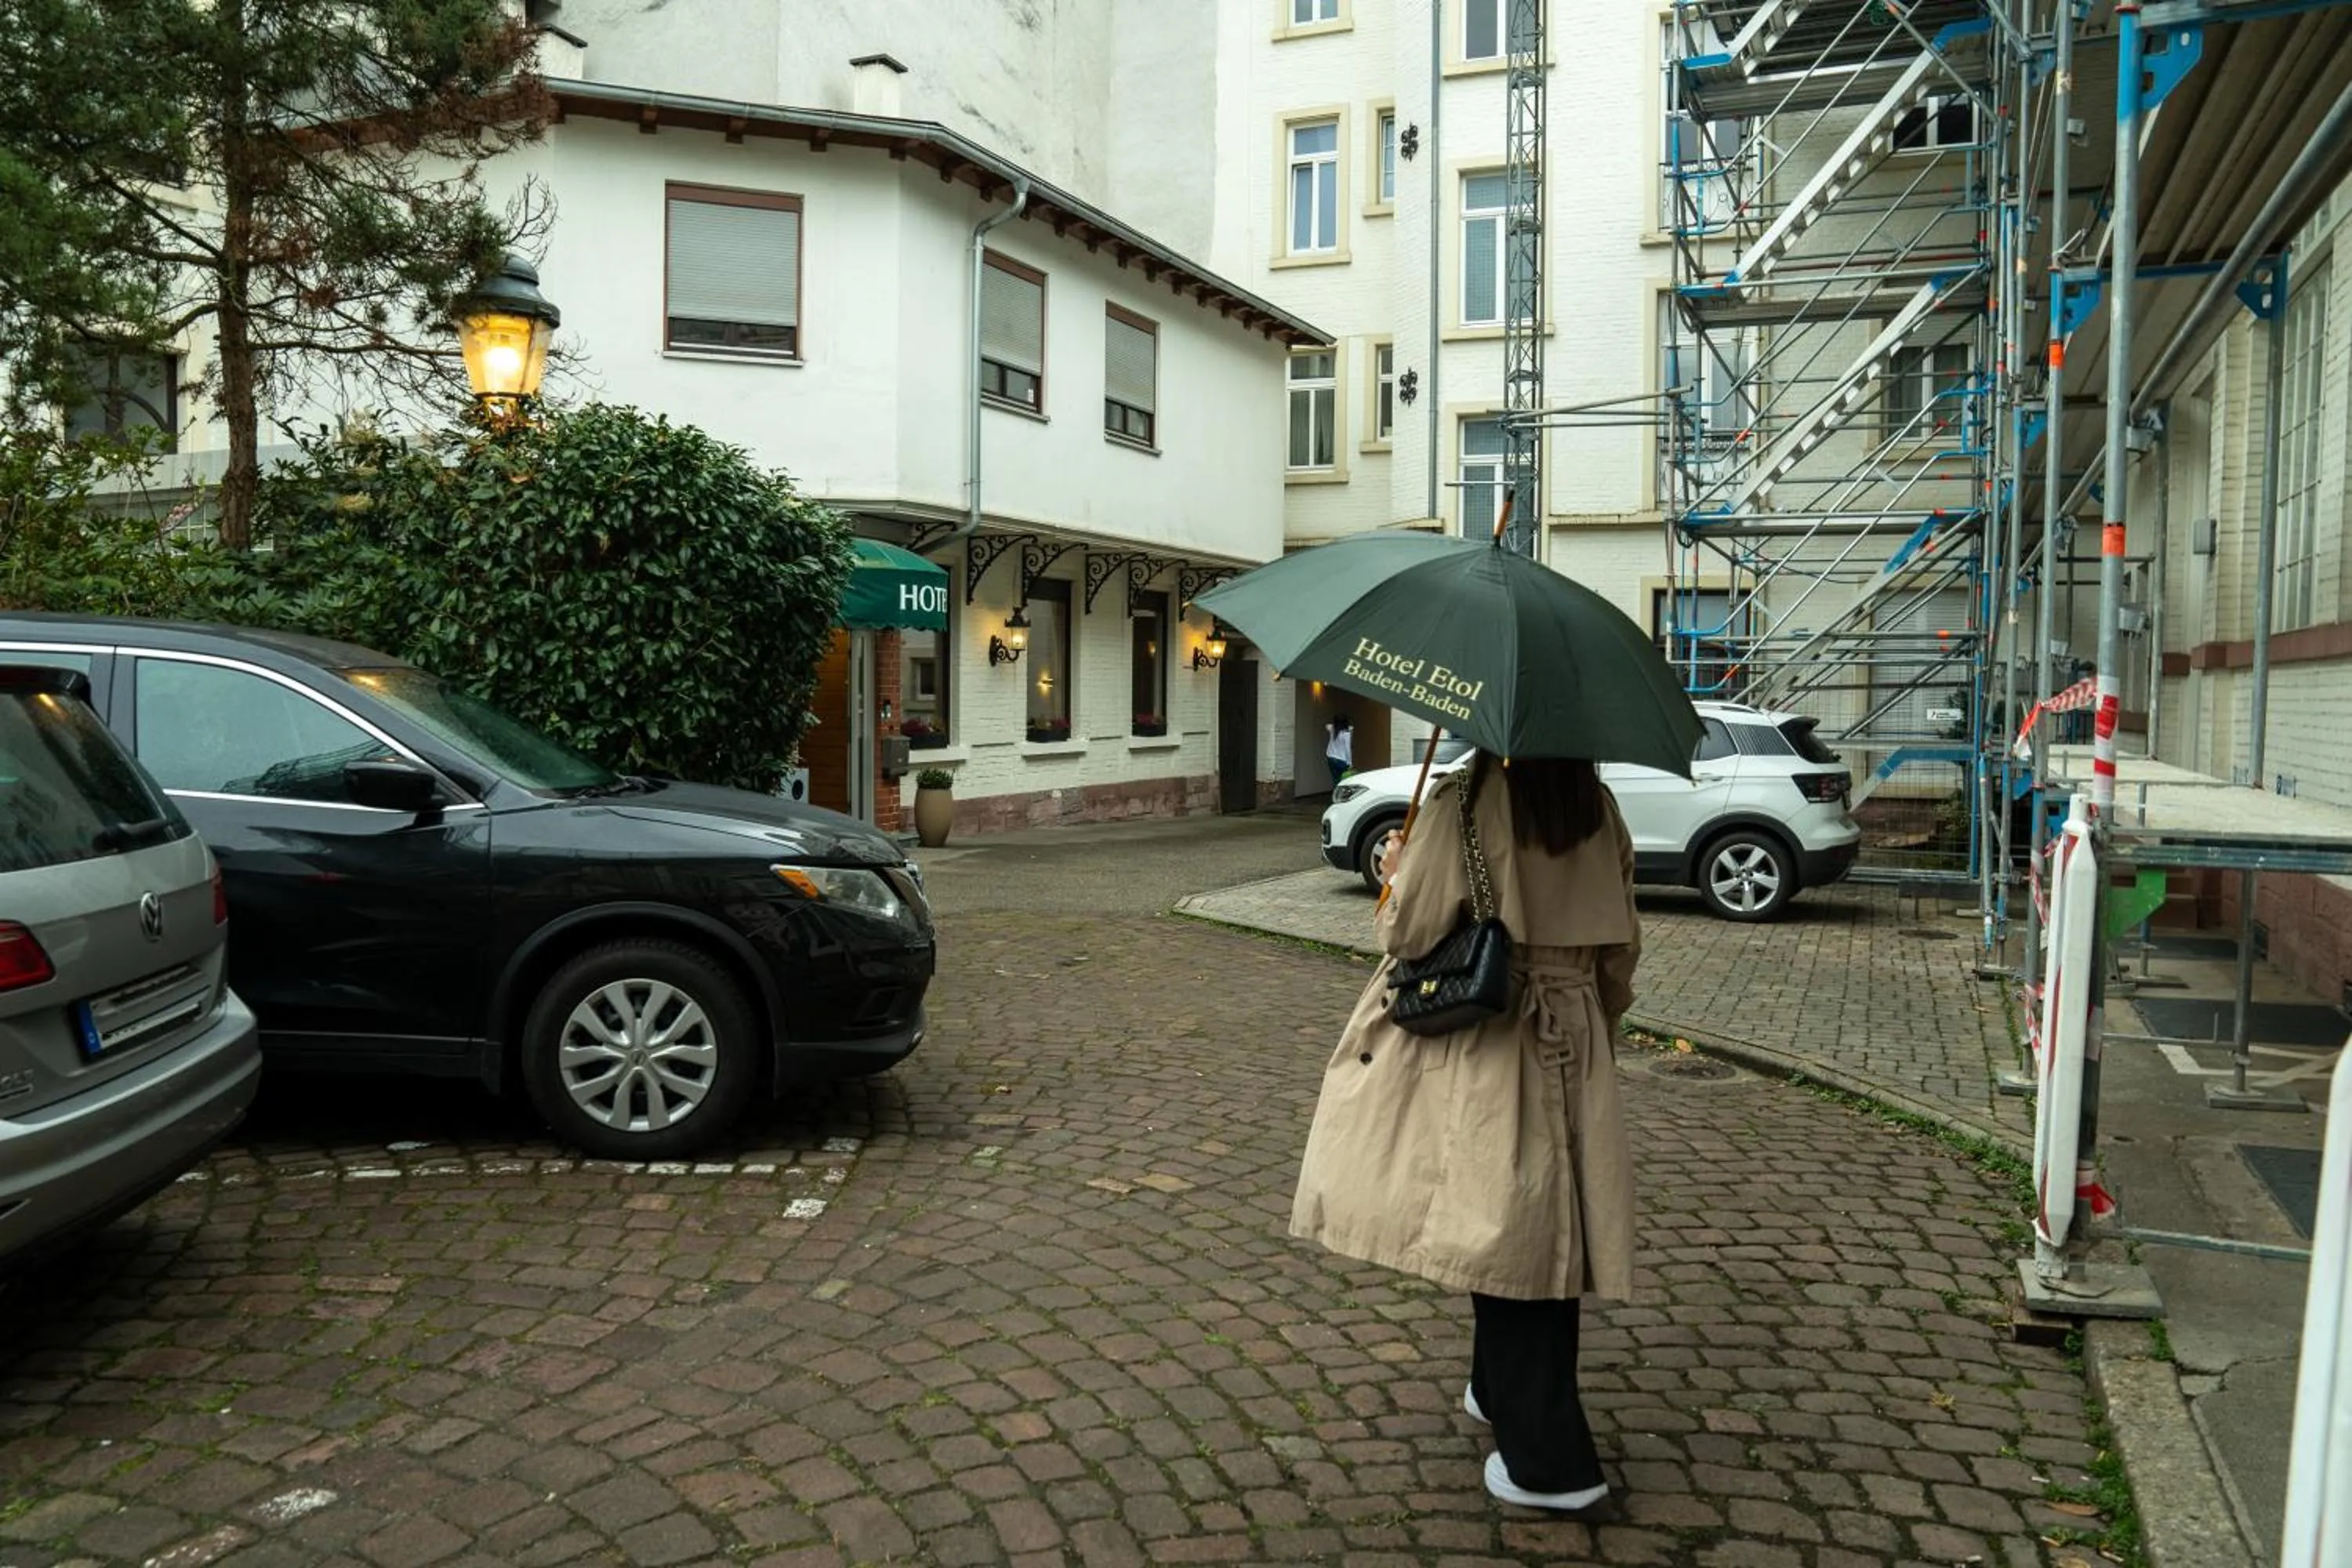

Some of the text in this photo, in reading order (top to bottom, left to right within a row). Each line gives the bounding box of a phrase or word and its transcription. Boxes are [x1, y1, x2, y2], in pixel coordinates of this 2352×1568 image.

[1343, 659, 1472, 720] Baden-Baden
[1352, 637, 1484, 701] Hotel Etol
